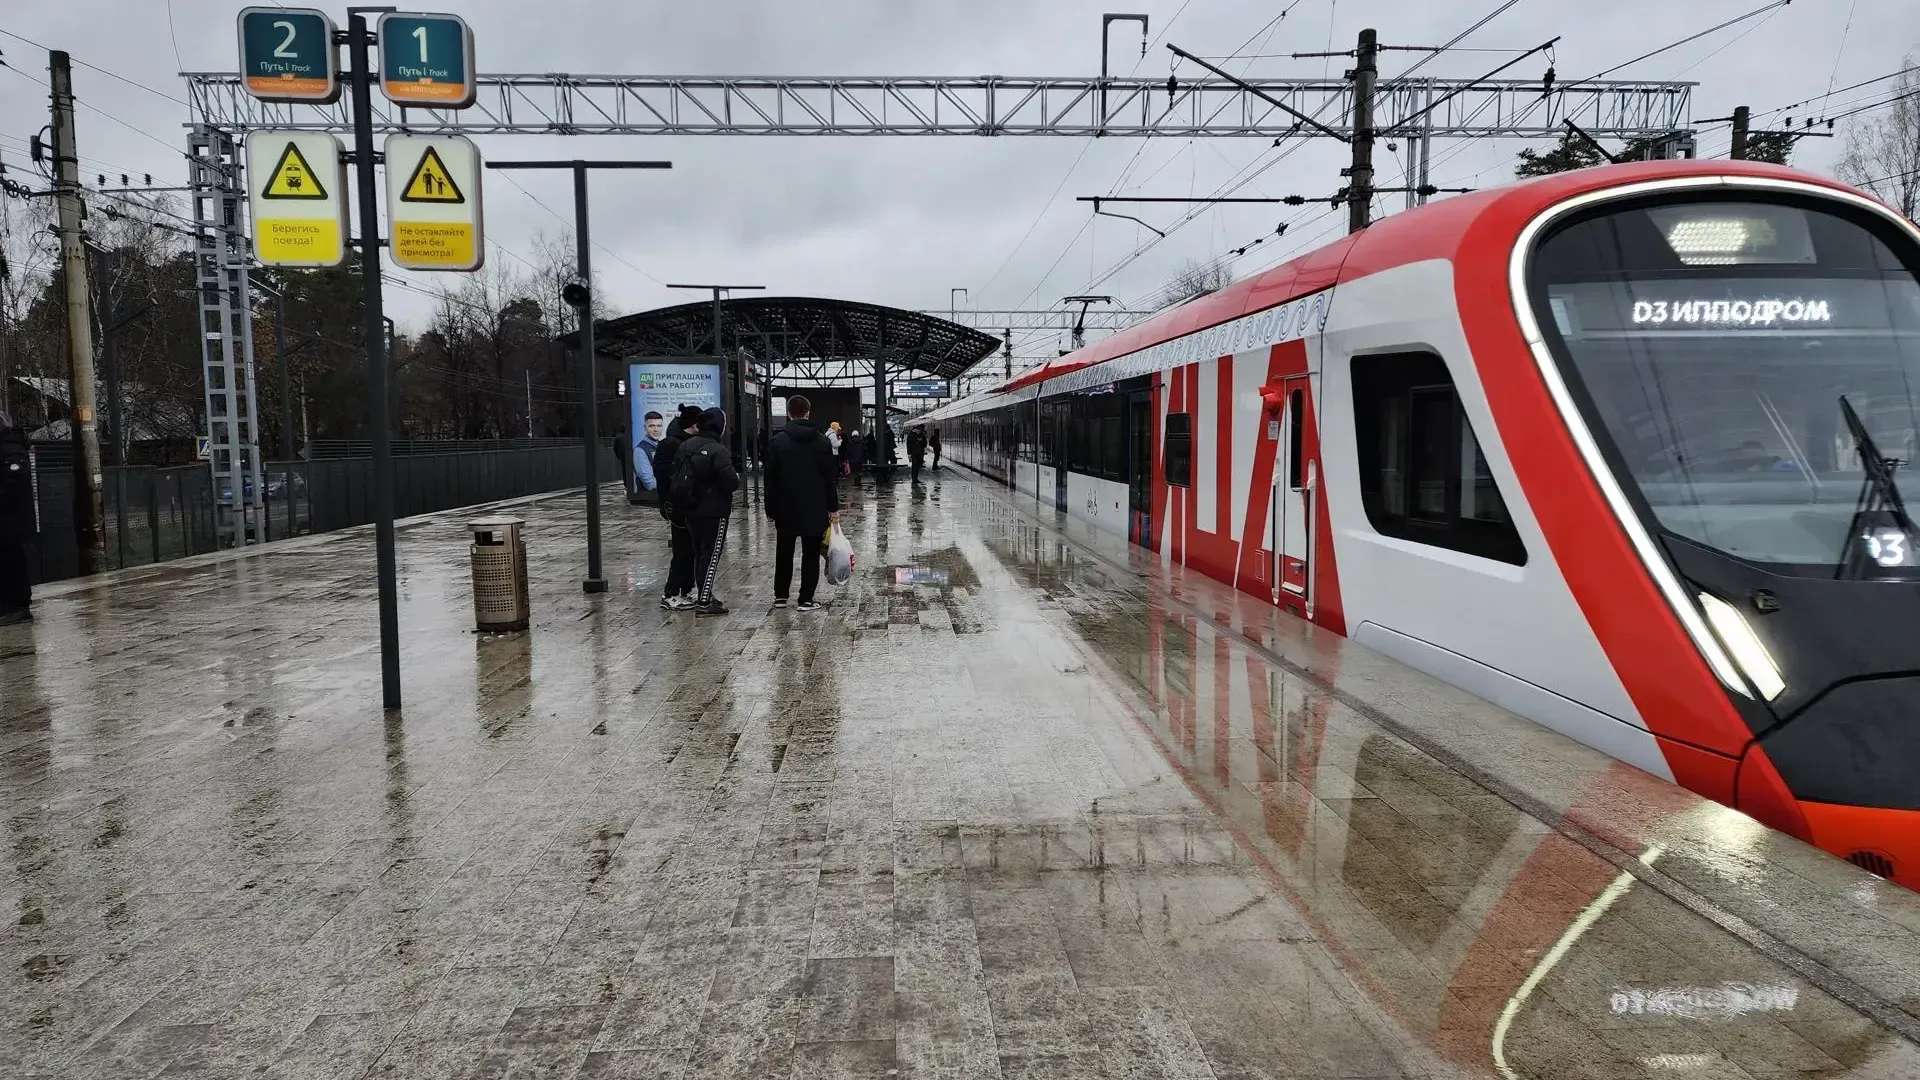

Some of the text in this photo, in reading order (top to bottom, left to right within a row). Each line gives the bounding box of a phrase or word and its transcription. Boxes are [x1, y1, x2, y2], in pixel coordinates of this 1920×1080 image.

[273, 20, 298, 58] 2
[412, 26, 428, 64] 1
[260, 62, 312, 72] Путь Track
[398, 66, 448, 77] Путь Track
[272, 224, 320, 234] Берегись
[400, 227, 465, 236] Не оставляйте
[273, 237, 314, 246] поезда!
[400, 238, 445, 246] детей без
[401, 249, 454, 257] присмотра!
[1631, 300, 1831, 324] D3 ИППОДРОМ
